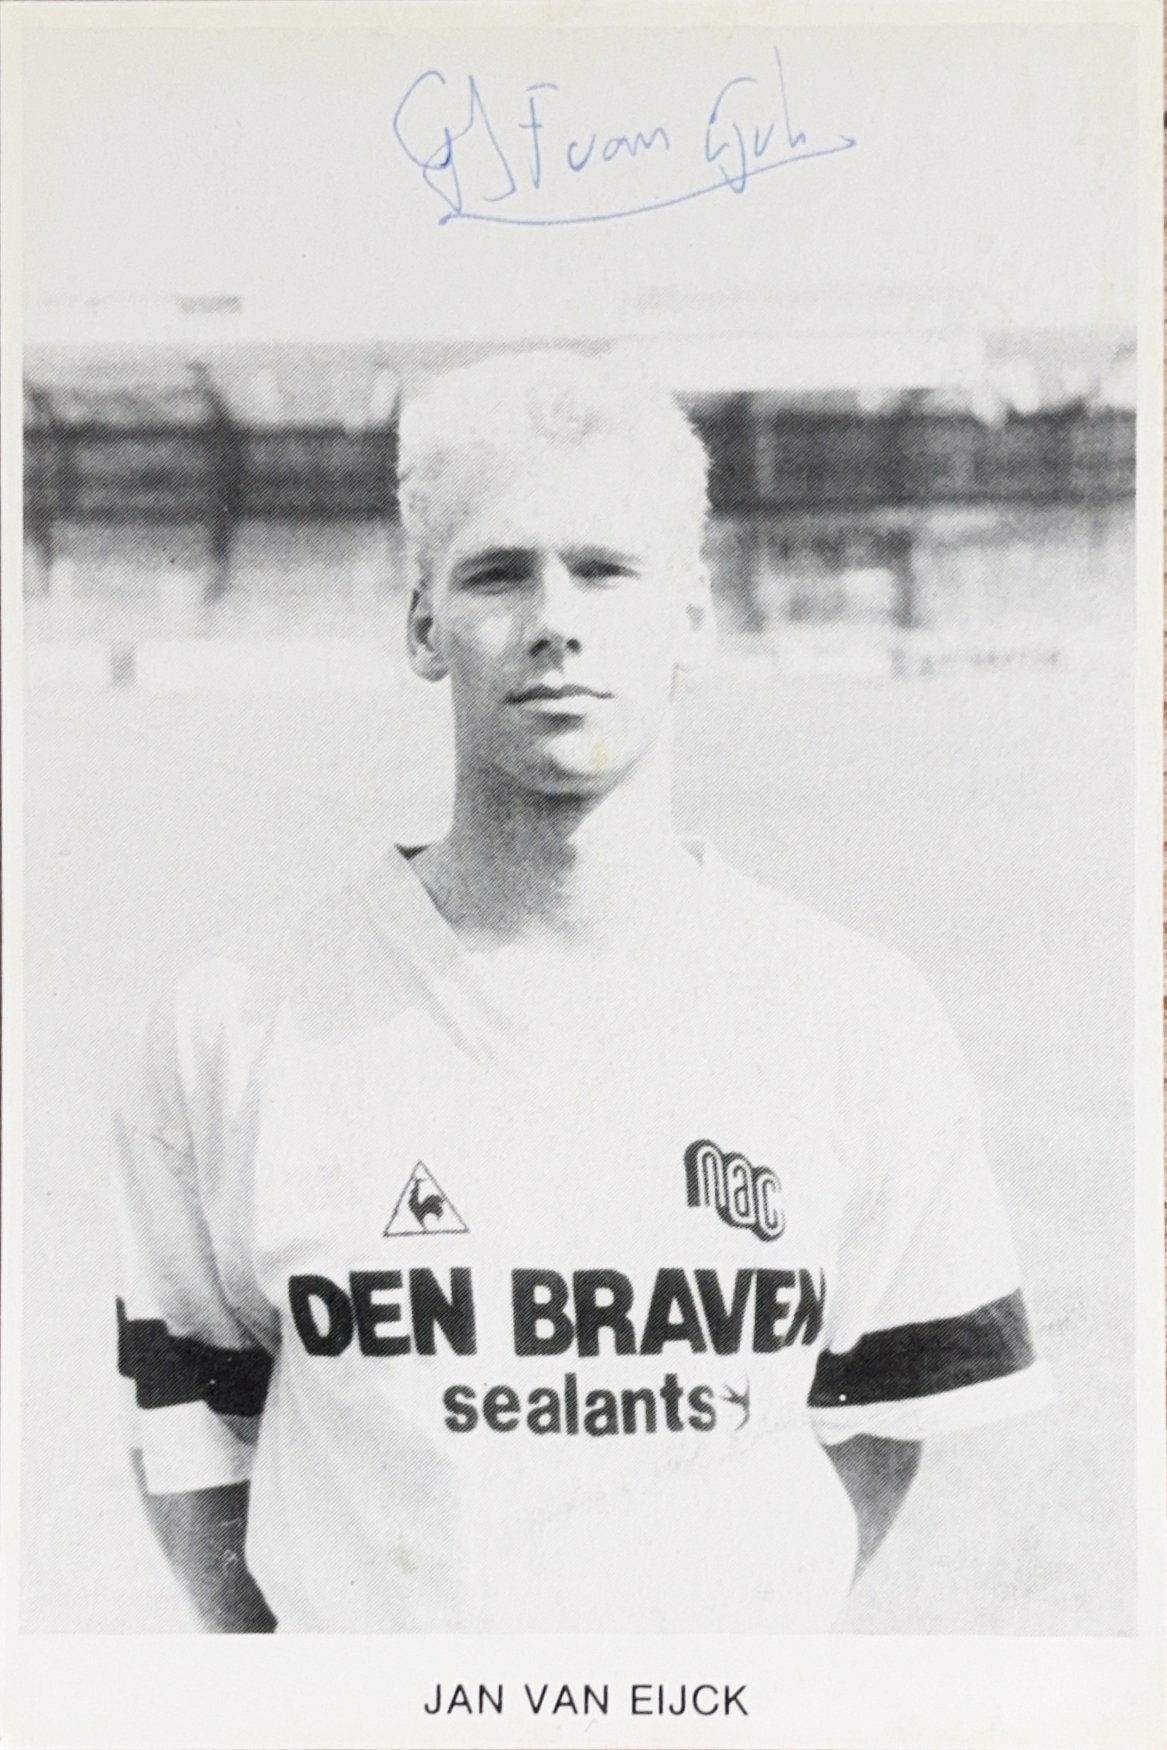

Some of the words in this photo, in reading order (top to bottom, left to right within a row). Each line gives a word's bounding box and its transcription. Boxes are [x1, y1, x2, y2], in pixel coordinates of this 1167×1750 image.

[289, 1267, 477, 1358] DEN
[512, 1267, 827, 1358] BRAVEN
[444, 1374, 717, 1436] sealants
[424, 1684, 503, 1715] JAN
[524, 1684, 608, 1715] VAN
[631, 1684, 748, 1716] EIJCK
